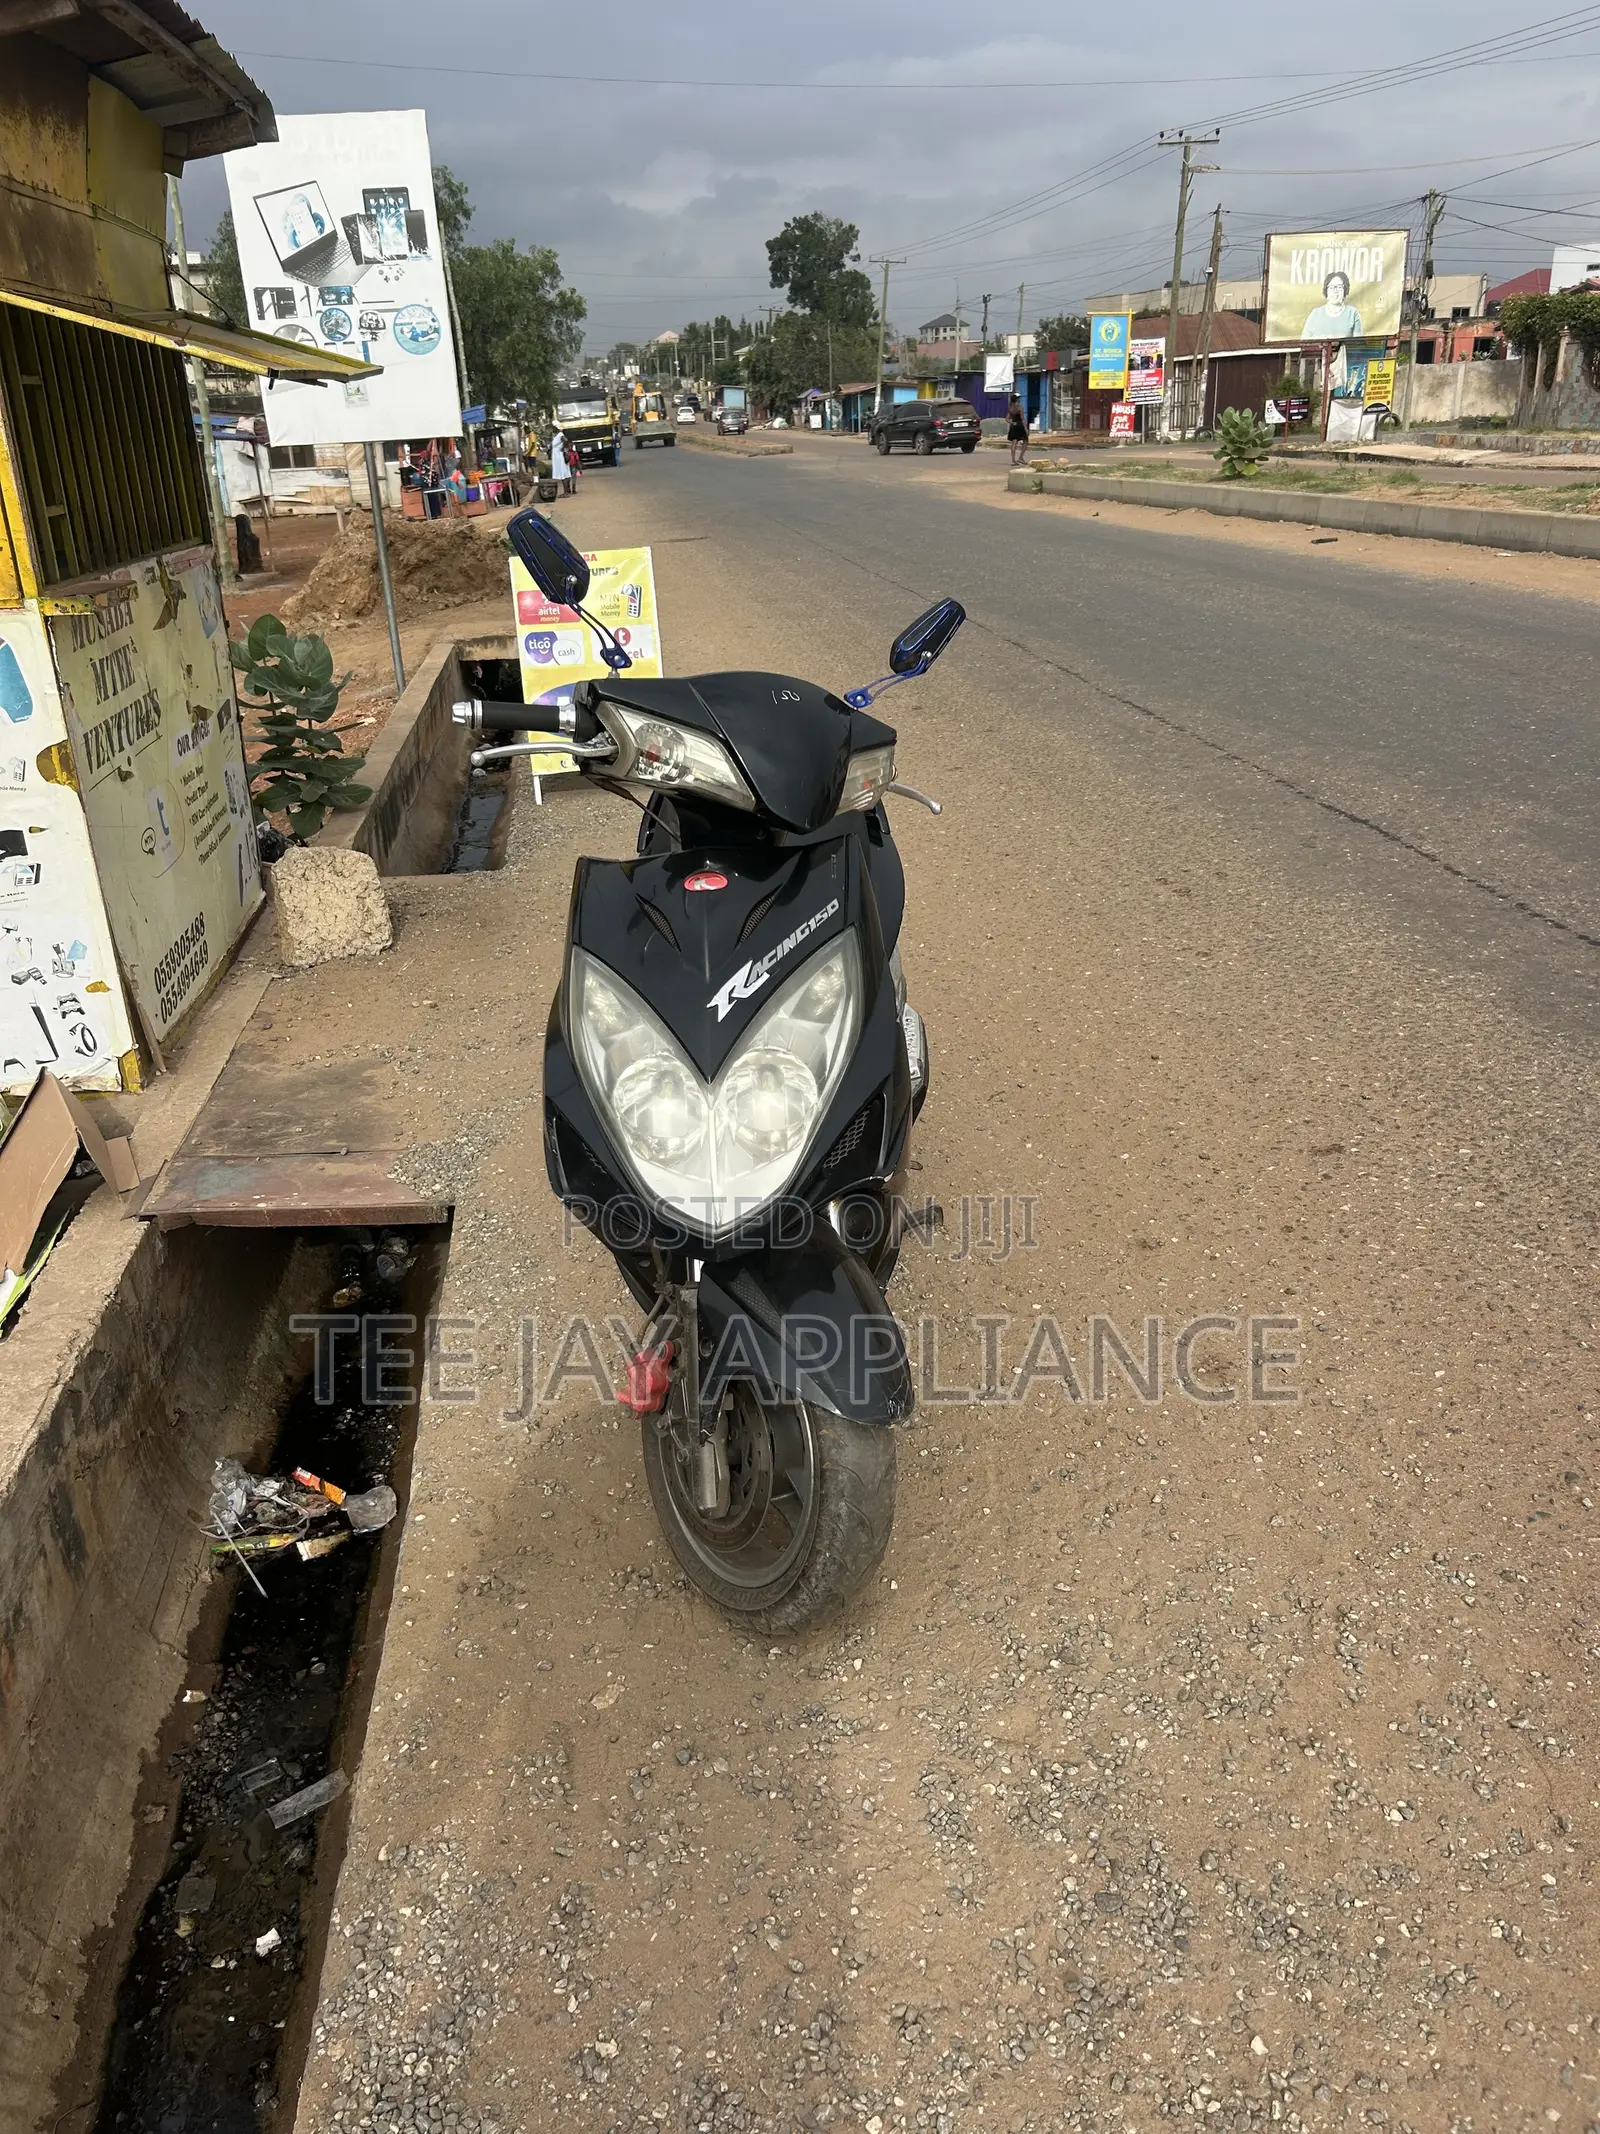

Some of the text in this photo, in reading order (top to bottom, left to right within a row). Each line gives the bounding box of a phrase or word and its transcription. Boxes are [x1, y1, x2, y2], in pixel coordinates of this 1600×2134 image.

[1290, 247, 1384, 285] KROWOR
[538, 606, 560, 616] airtel
[557, 648, 576, 656] cash
[82, 688, 163, 775] VENTURES
[153, 911, 206, 994] 0559305488
[160, 940, 209, 1025] 0554994649
